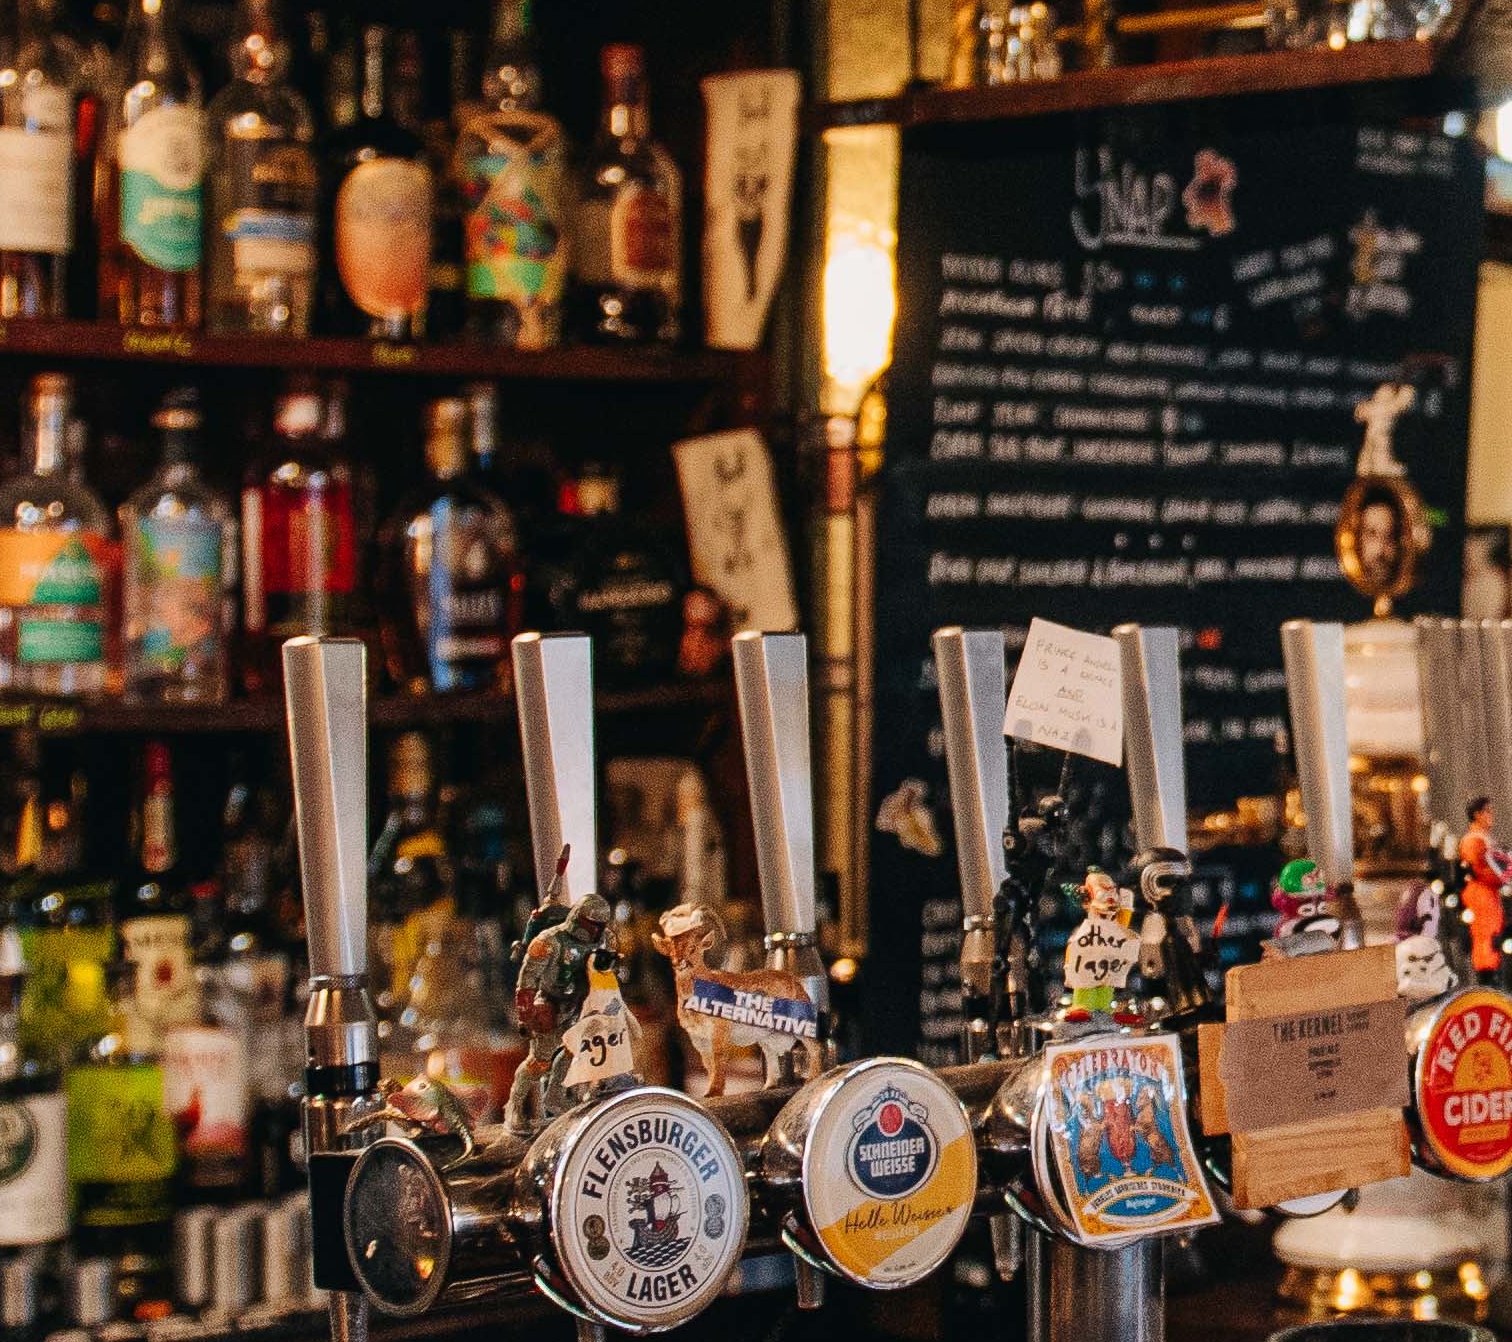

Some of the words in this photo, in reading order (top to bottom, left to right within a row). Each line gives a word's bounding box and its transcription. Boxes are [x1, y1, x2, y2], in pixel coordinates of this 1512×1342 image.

[1077, 922, 1128, 951] other
[1074, 955, 1131, 984] lager
[734, 991, 774, 1011] THE
[684, 996, 817, 1038] ALTERNATIVE
[1272, 1019, 1295, 1043] THE
[1298, 1013, 1343, 1039] KERNEL
[1438, 1012, 1481, 1072] RED
[582, 1118, 719, 1199] FLENSBURGER
[859, 1137, 925, 1161] SCHNEIDER
[871, 1156, 916, 1177] WEISSE
[626, 1264, 698, 1302] LAGER
